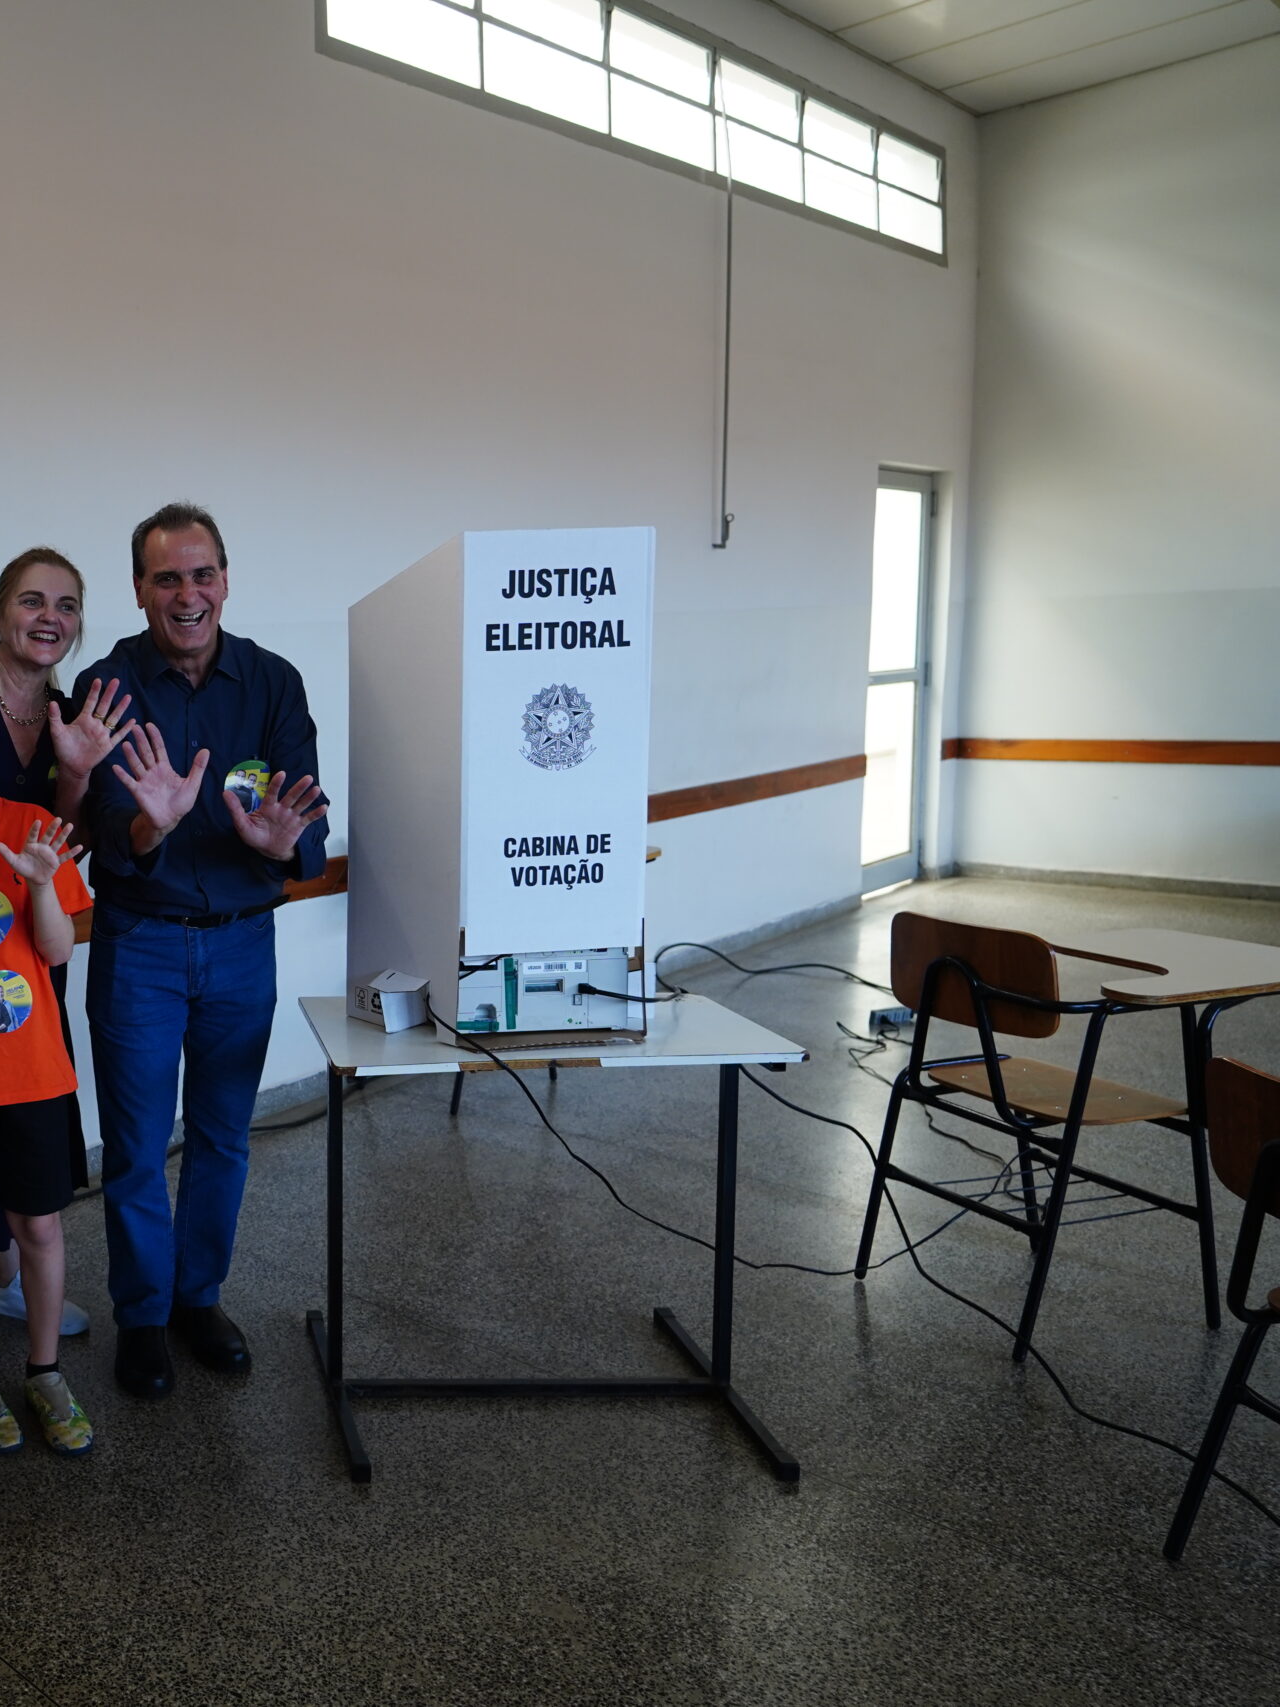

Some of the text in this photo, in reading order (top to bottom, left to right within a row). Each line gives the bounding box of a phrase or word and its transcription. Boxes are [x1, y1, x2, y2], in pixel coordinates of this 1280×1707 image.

[502, 567, 616, 604] JUSTIÇA
[486, 620, 630, 651] ELEITORAL
[504, 833, 611, 858] CABINA DE
[511, 858, 604, 890] VOTAÇÃO
